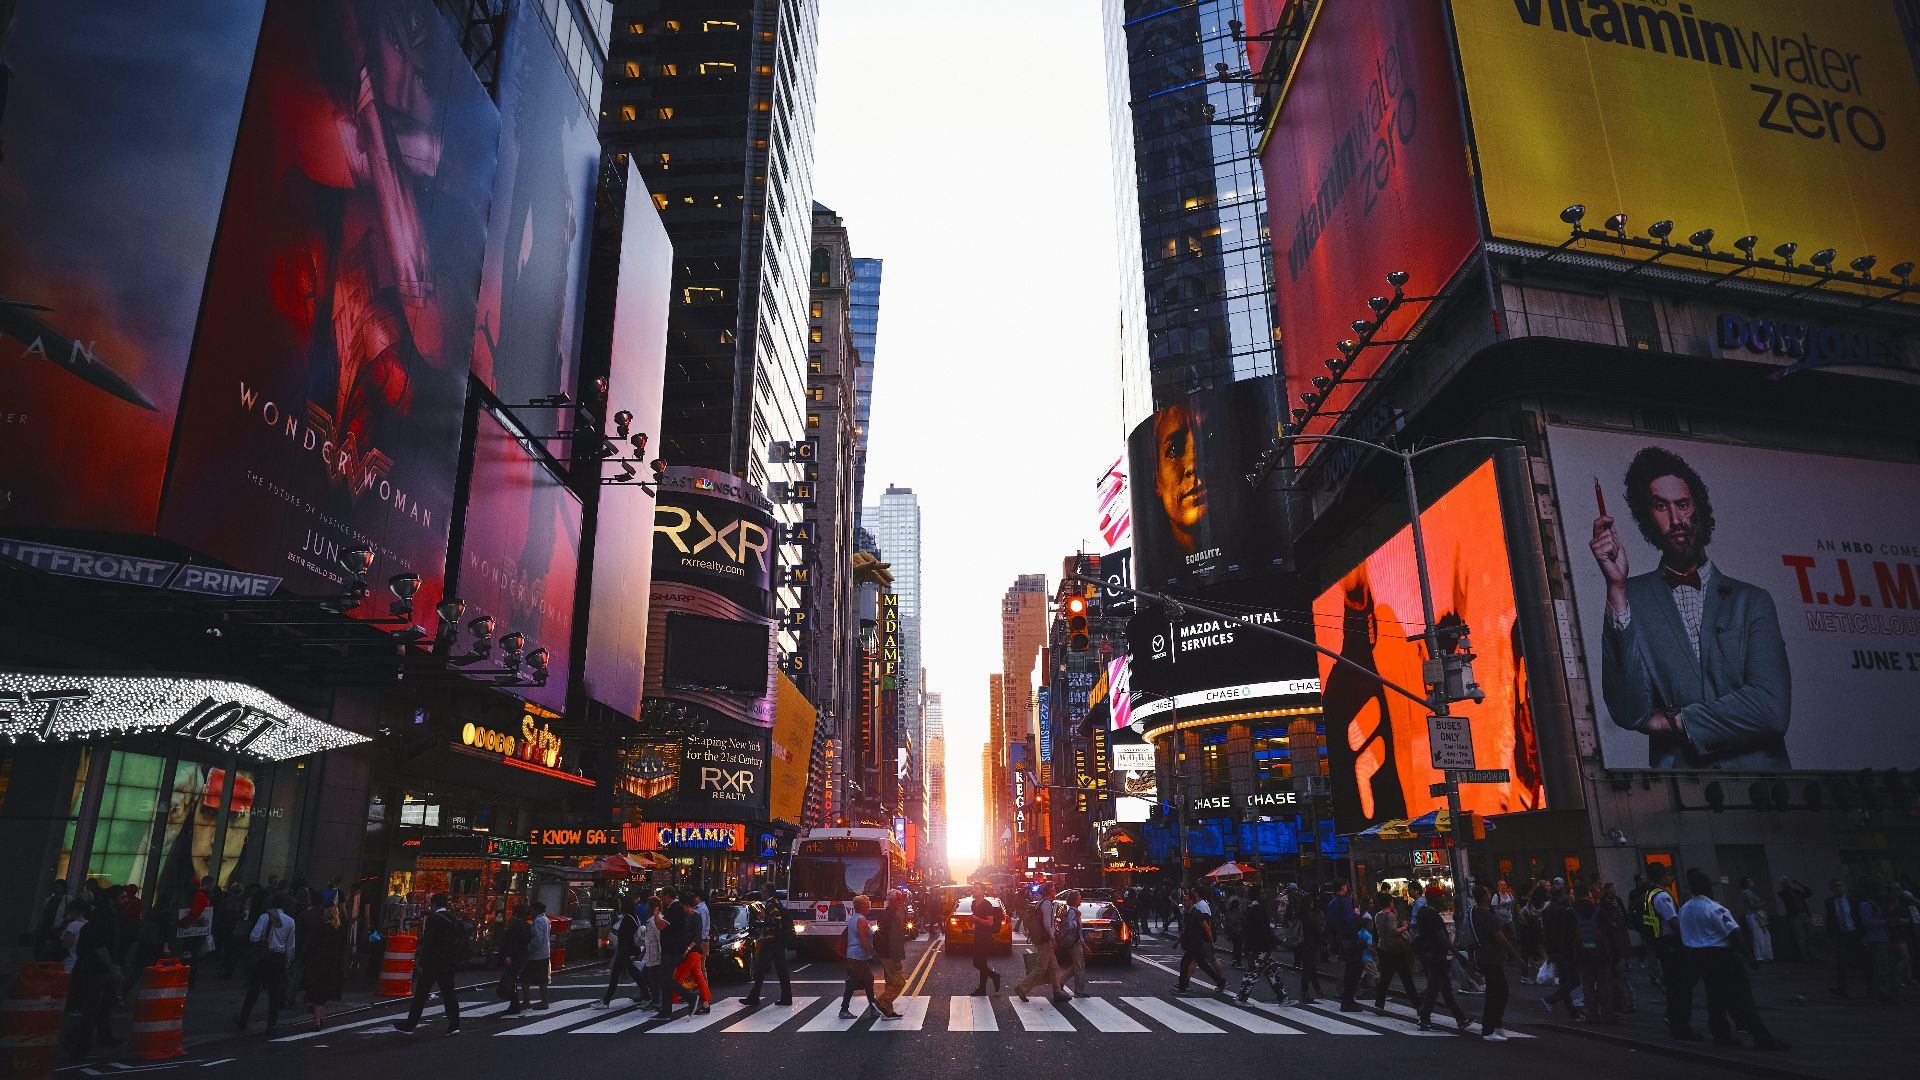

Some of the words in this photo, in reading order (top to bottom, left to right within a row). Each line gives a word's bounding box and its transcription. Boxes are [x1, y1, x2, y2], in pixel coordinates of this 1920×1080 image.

[1512, 0, 1864, 97] vitaminwater
[1750, 83, 1887, 152] zero
[1363, 87, 1417, 218] zero
[240, 380, 352, 475] WONDER
[362, 465, 432, 529] WOMAN
[302, 528, 341, 563] JUN
[653, 504, 769, 575] RXR
[1817, 539, 1837, 553] AN
[1841, 541, 1876, 555] HBO
[793, 444, 812, 671] CHAMPS
[1186, 547, 1222, 565] EQUALITY.
[470, 551, 524, 601] WONDER
[681, 557, 746, 577] rxrrealty.com
[185, 568, 270, 597] PRIME
[1782, 554, 1873, 608] T.J.
[1871, 560, 1920, 612] M
[649, 592, 697, 603] SHARP
[883, 594, 899, 675] MADAME
[1180, 620, 1221, 638] MAZDA
[1804, 610, 1920, 638] METICULOU
[1181, 632, 1234, 652] SERVICES
[1850, 648, 1904, 671] JUNE
[1206, 688, 1240, 702] CHASE
[1289, 681, 1321, 693] CHAS
[1436, 720, 1462, 731] BUSES
[728, 738, 746, 749] New
[747, 741, 761, 752] York
[1441, 732, 1460, 742] ONLY
[686, 749, 702, 760] for
[704, 750, 719, 761] the
[720, 752, 737, 763] 21st
[738, 753, 763, 770] Century
[1096, 728, 1107, 773] VICTORY
[700, 766, 755, 794] RXR
[1470, 771, 1508, 782] Broadway
[712, 791, 746, 801] REALTY
[1097, 778, 1108, 801] NW
[1247, 792, 1297, 806] CHASE
[1077, 793, 1087, 812] NEW
[542, 829, 581, 845] KNOW
[658, 828, 736, 847] CHAMPS
[1414, 850, 1440, 864] SODA
